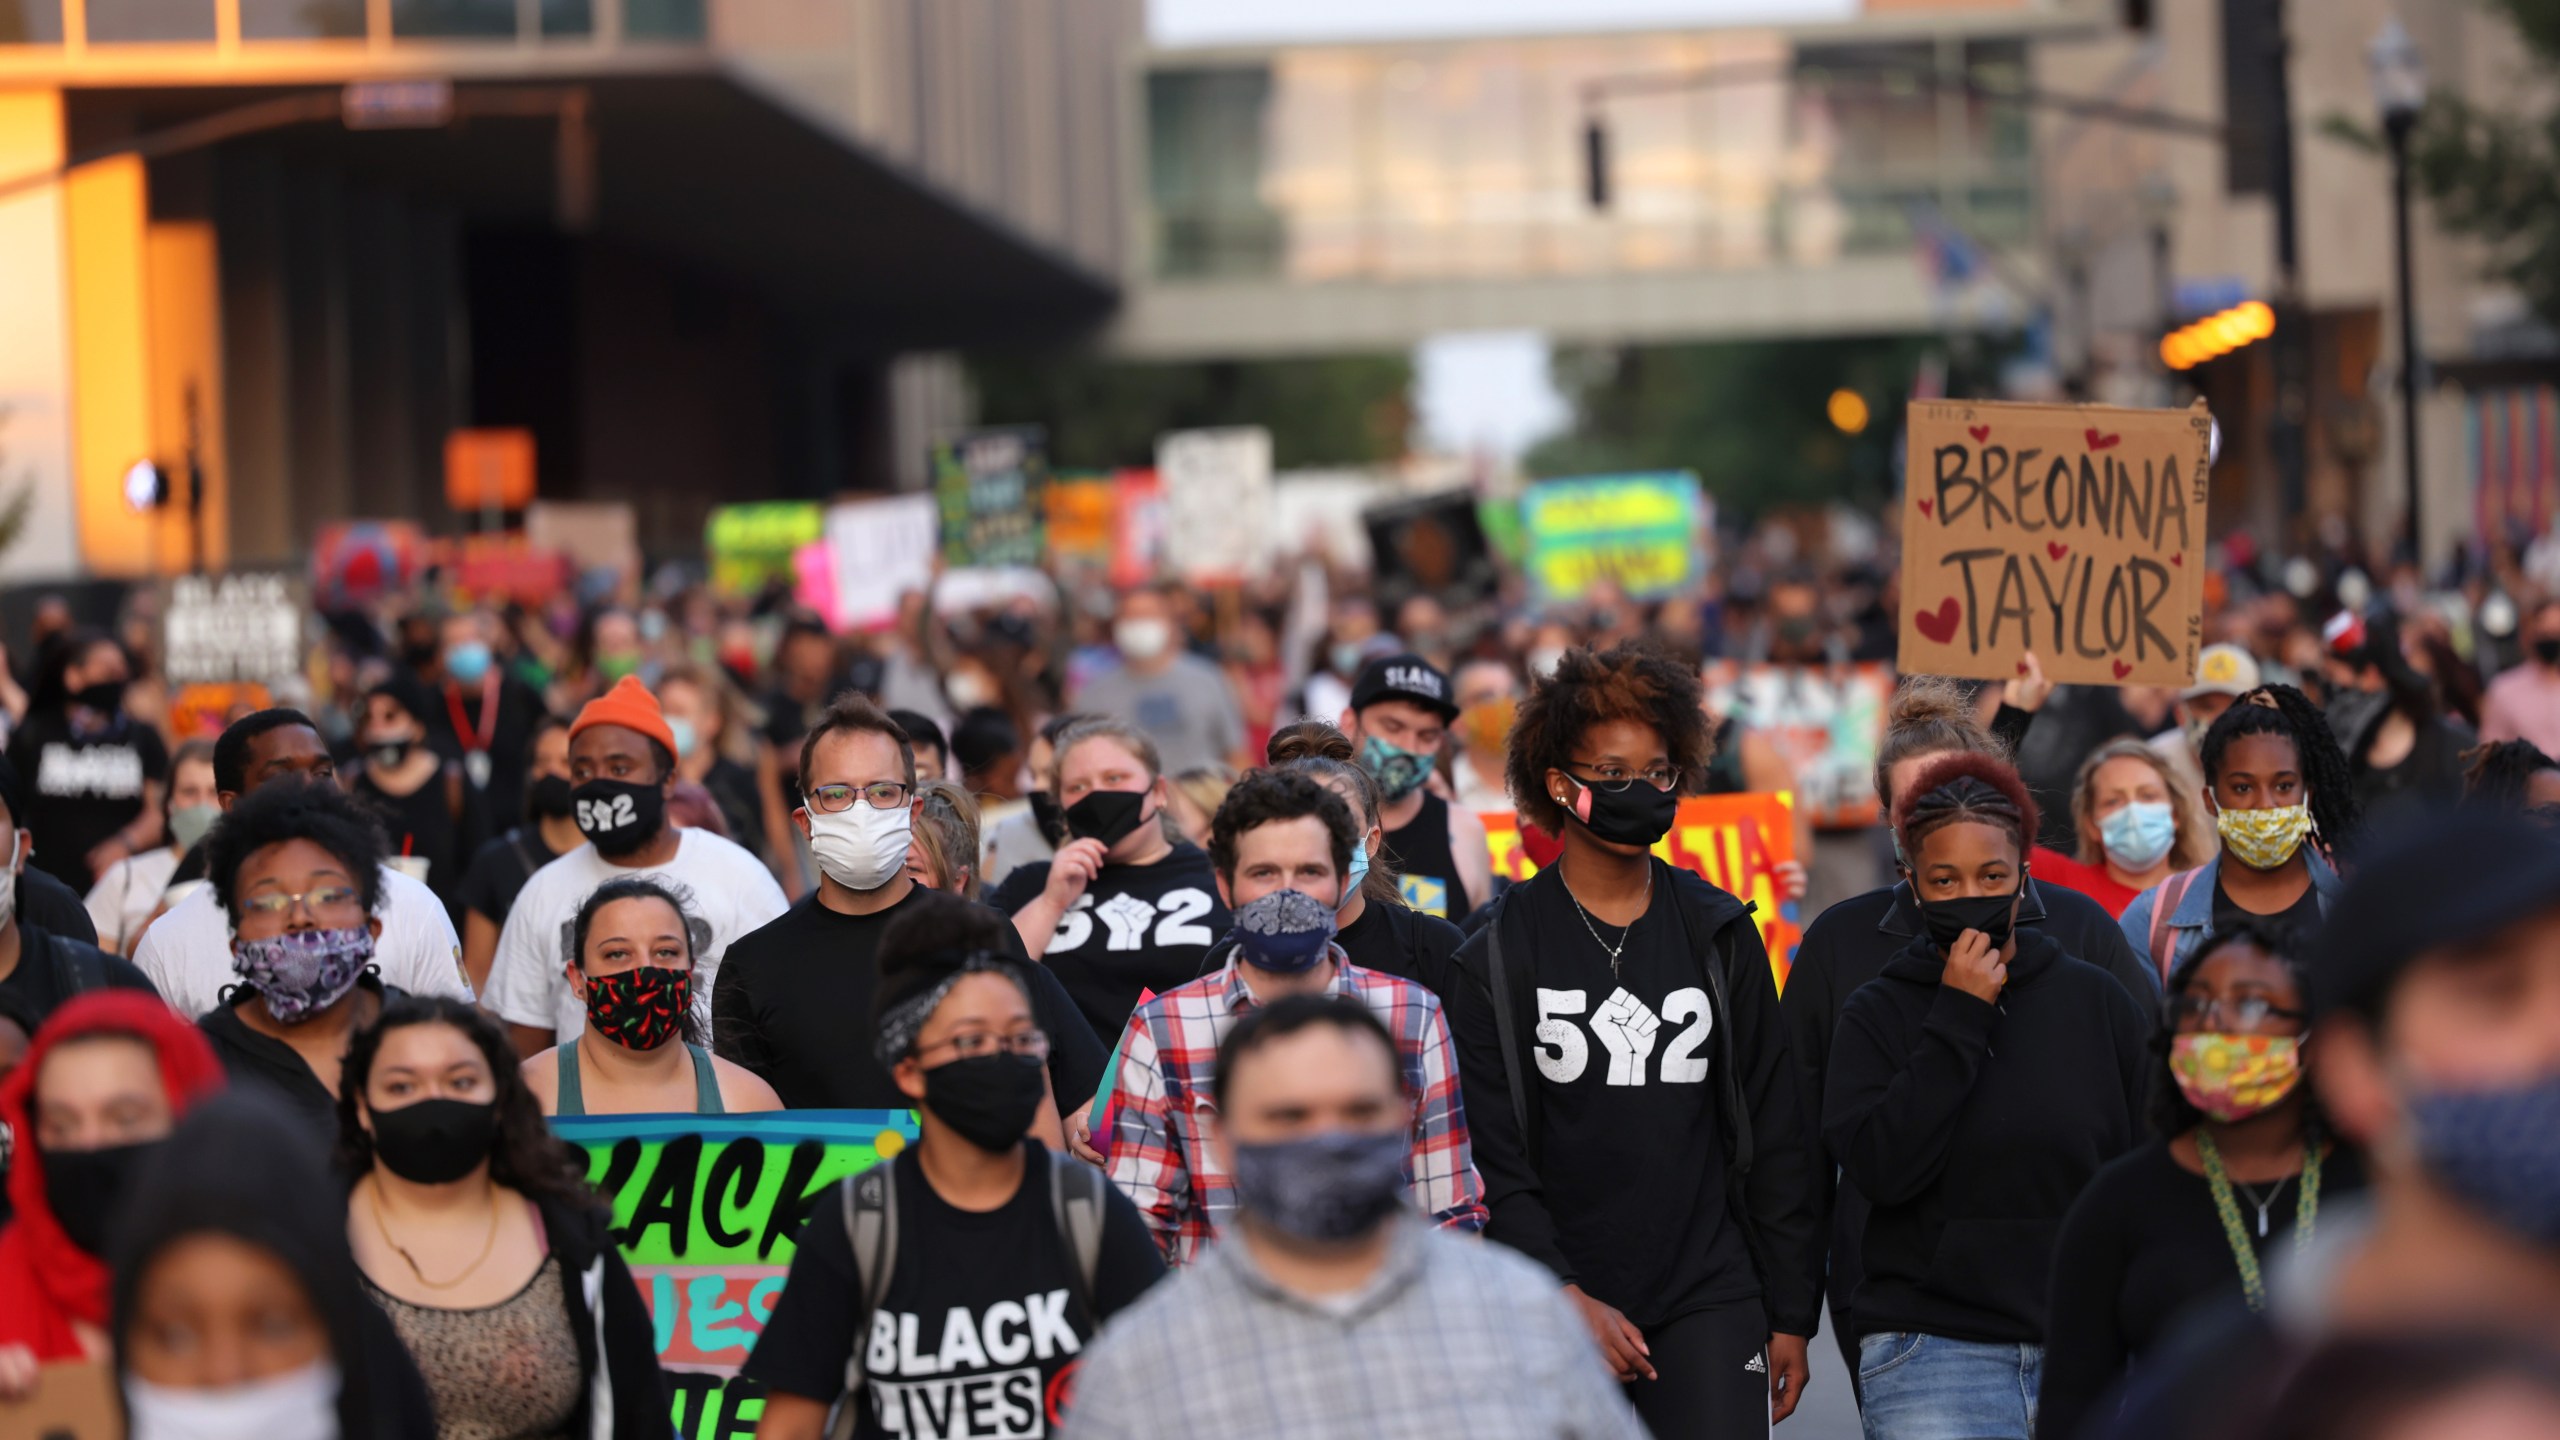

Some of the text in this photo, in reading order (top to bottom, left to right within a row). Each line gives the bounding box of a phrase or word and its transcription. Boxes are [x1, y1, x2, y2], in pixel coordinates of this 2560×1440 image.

[1933, 443, 2189, 551] BREONNA
[1940, 547, 2178, 662] TAYLOR
[866, 1288, 1083, 1377] BLACK
[872, 1374, 1036, 1440] LIVES
